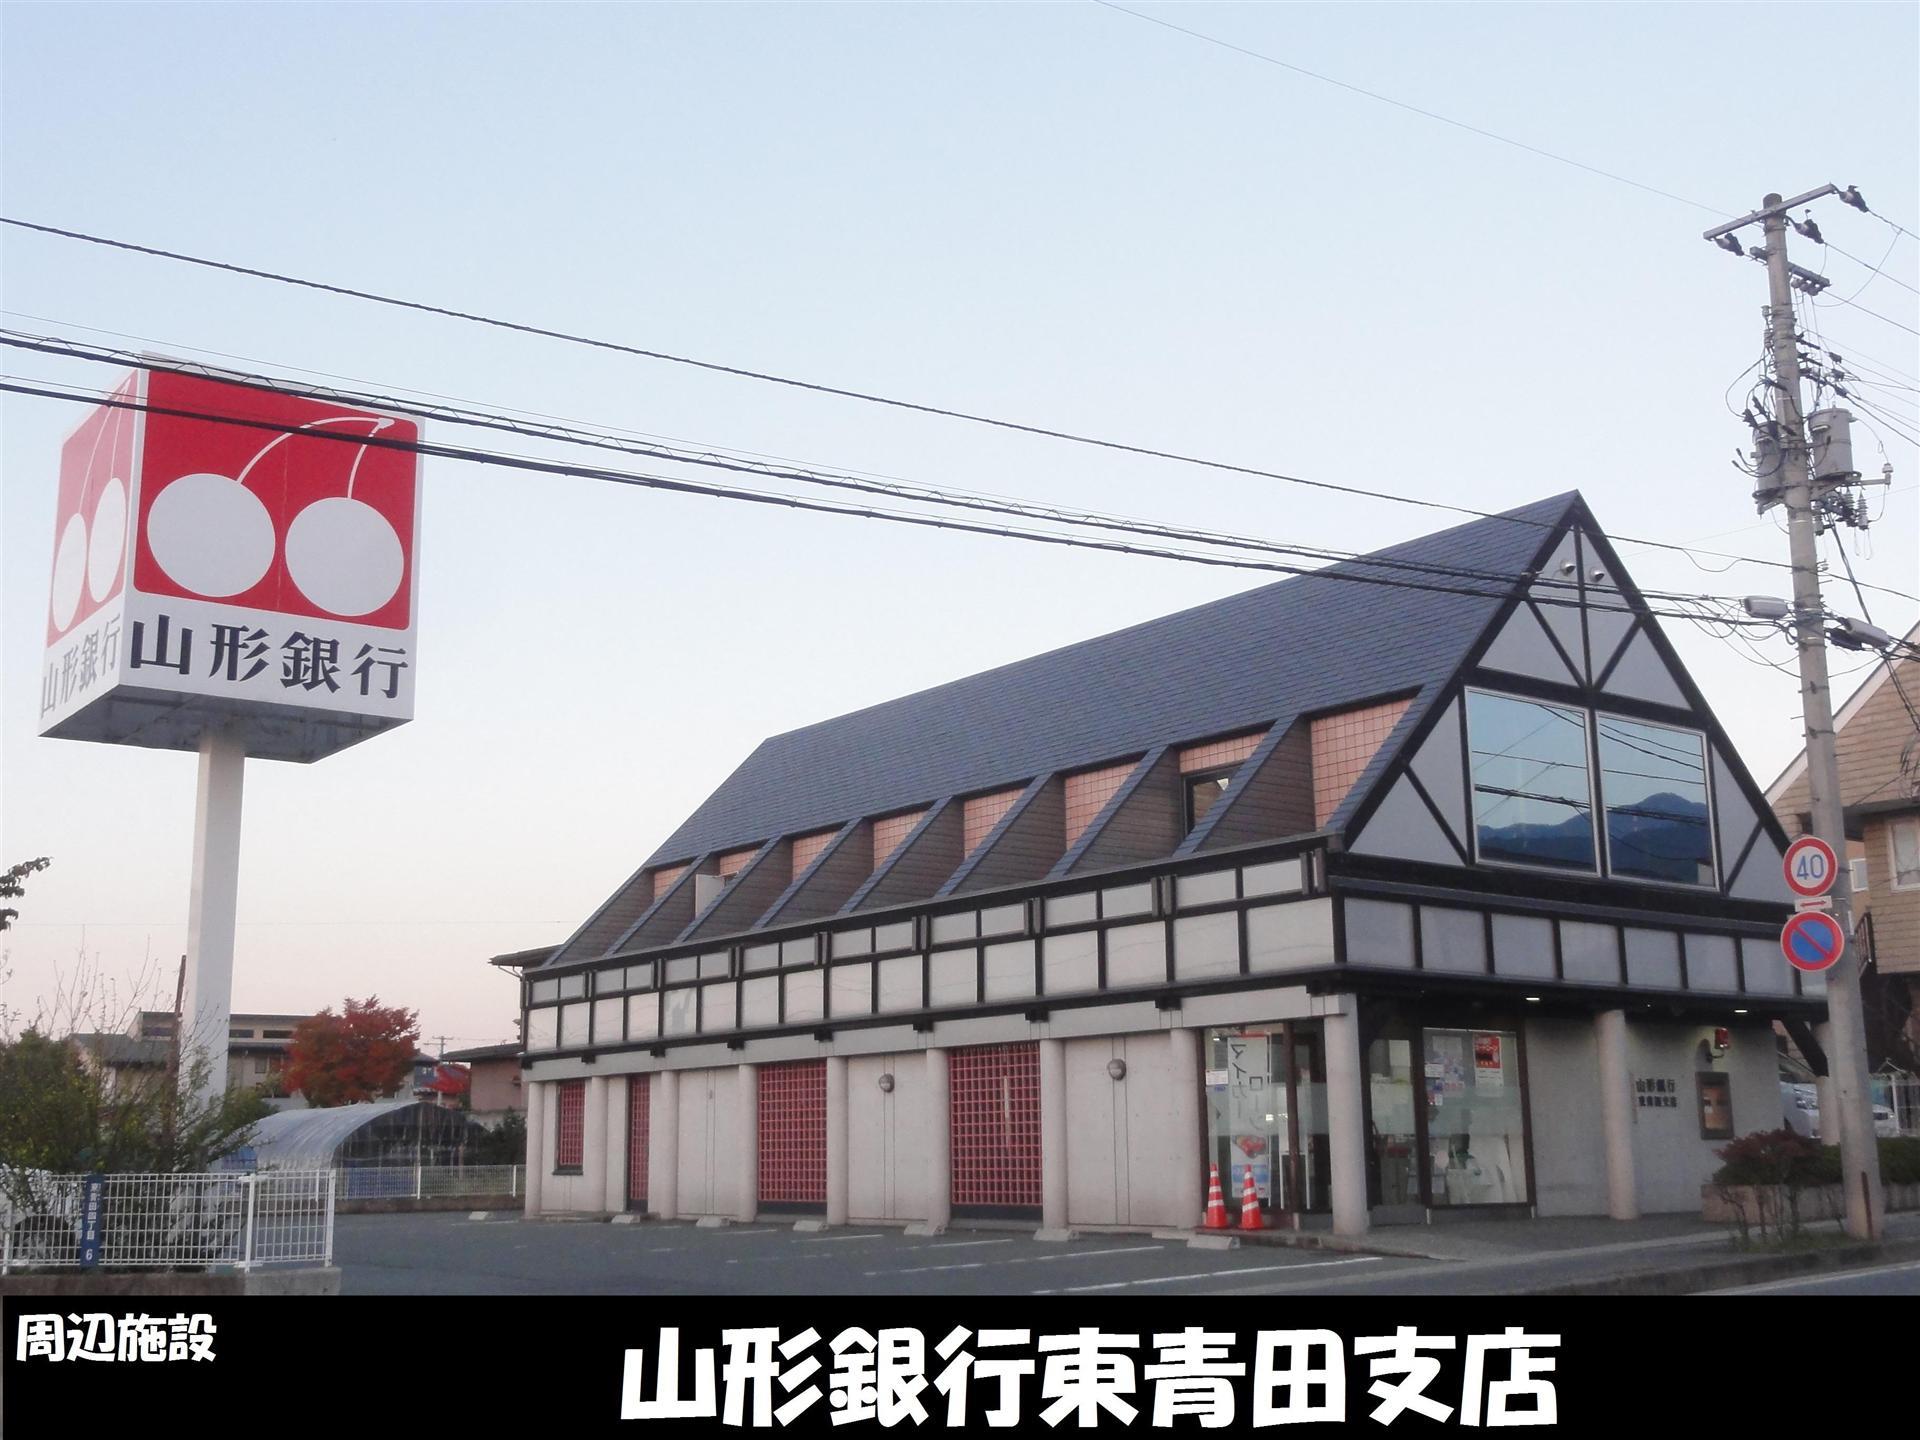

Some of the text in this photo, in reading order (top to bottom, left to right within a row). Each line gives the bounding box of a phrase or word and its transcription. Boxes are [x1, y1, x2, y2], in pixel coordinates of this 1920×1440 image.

[40, 612, 121, 720] 山形銀行
[130, 613, 409, 699] 山形銀行
[1797, 854, 1824, 880] 40
[85, 1248, 93, 1261] 6
